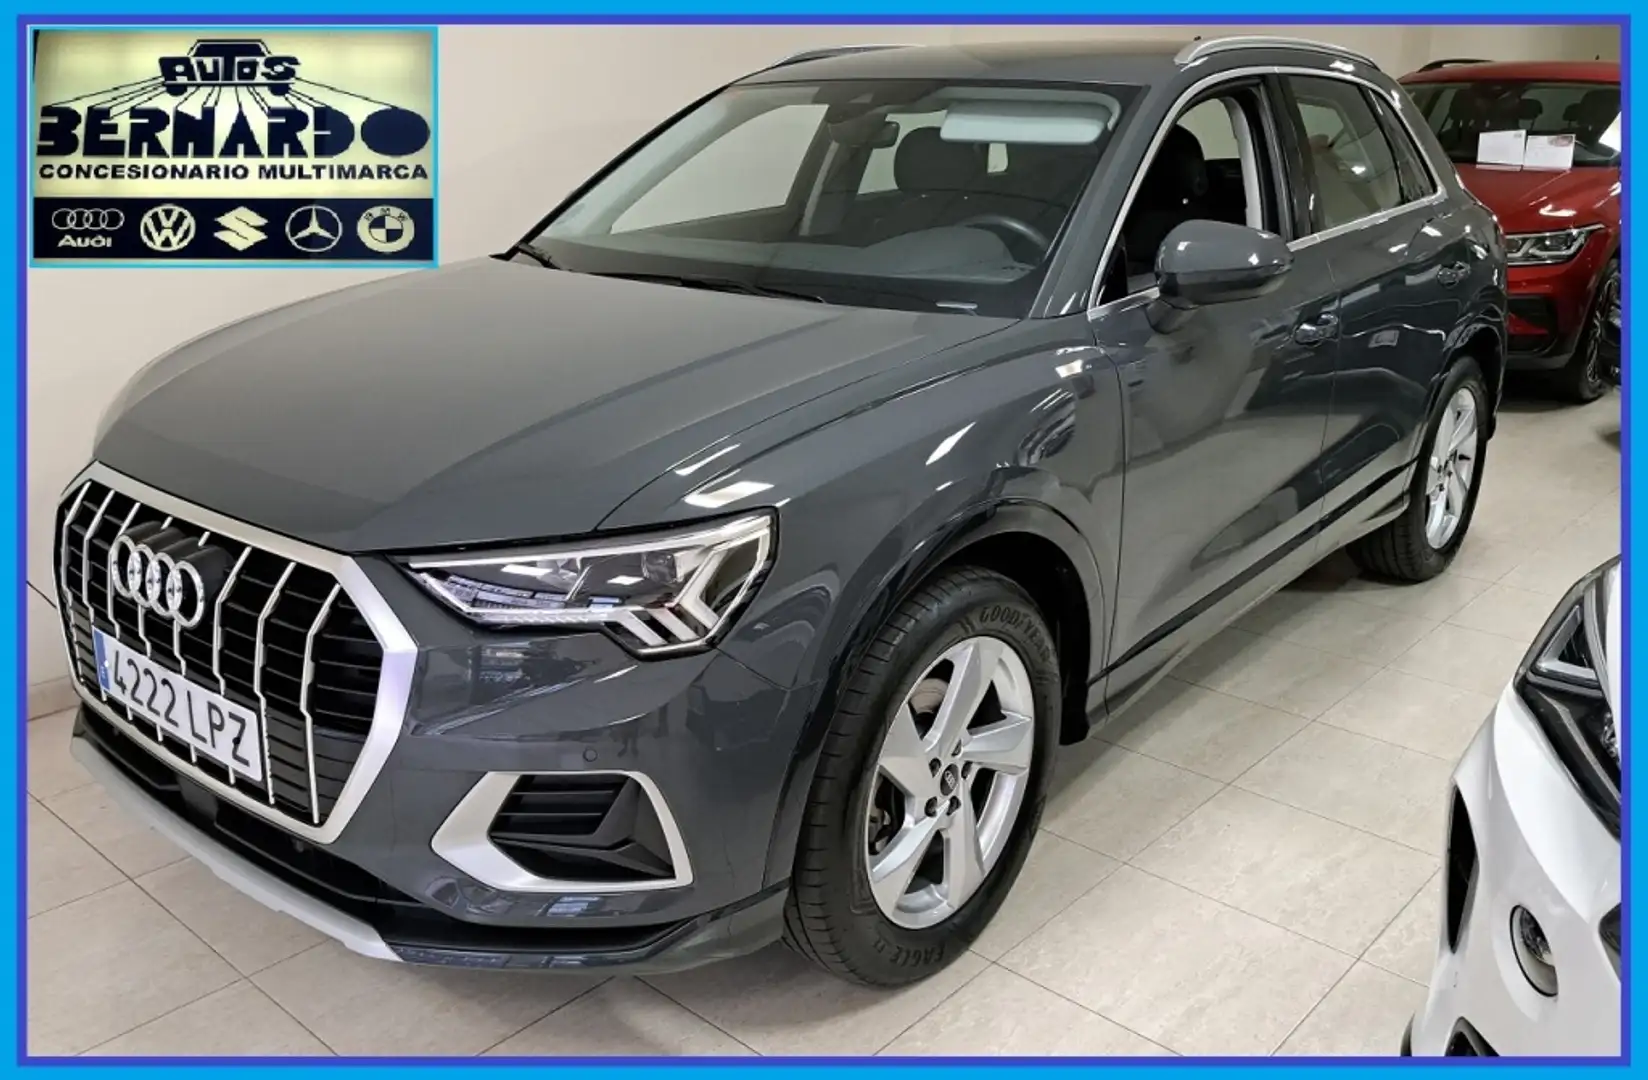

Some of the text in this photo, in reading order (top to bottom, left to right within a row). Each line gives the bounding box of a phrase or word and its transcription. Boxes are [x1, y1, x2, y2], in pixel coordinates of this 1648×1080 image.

[979, 605, 1051, 662] GOODYEAR
[112, 650, 251, 767] 4222 LPZ
[889, 942, 946, 967] EAGLE
